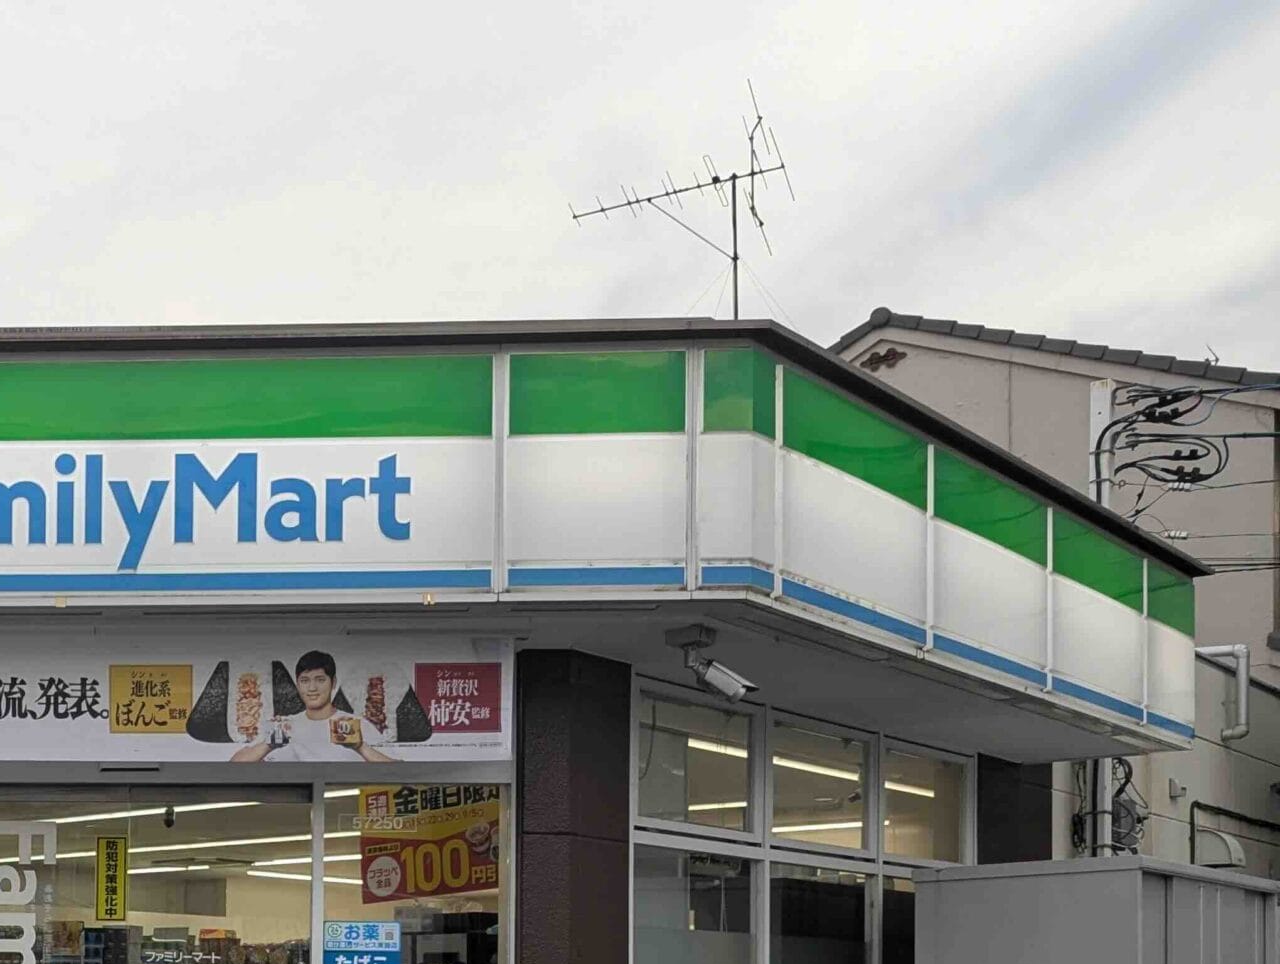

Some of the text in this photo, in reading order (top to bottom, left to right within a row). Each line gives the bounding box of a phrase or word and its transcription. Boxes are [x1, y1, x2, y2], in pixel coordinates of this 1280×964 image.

[130, 680, 171, 697] 進化系
[436, 679, 479, 697] 新贅沢
[105, 840, 118, 918] 防犯対策強化中
[145, 951, 221, 964] ファミリーマート
